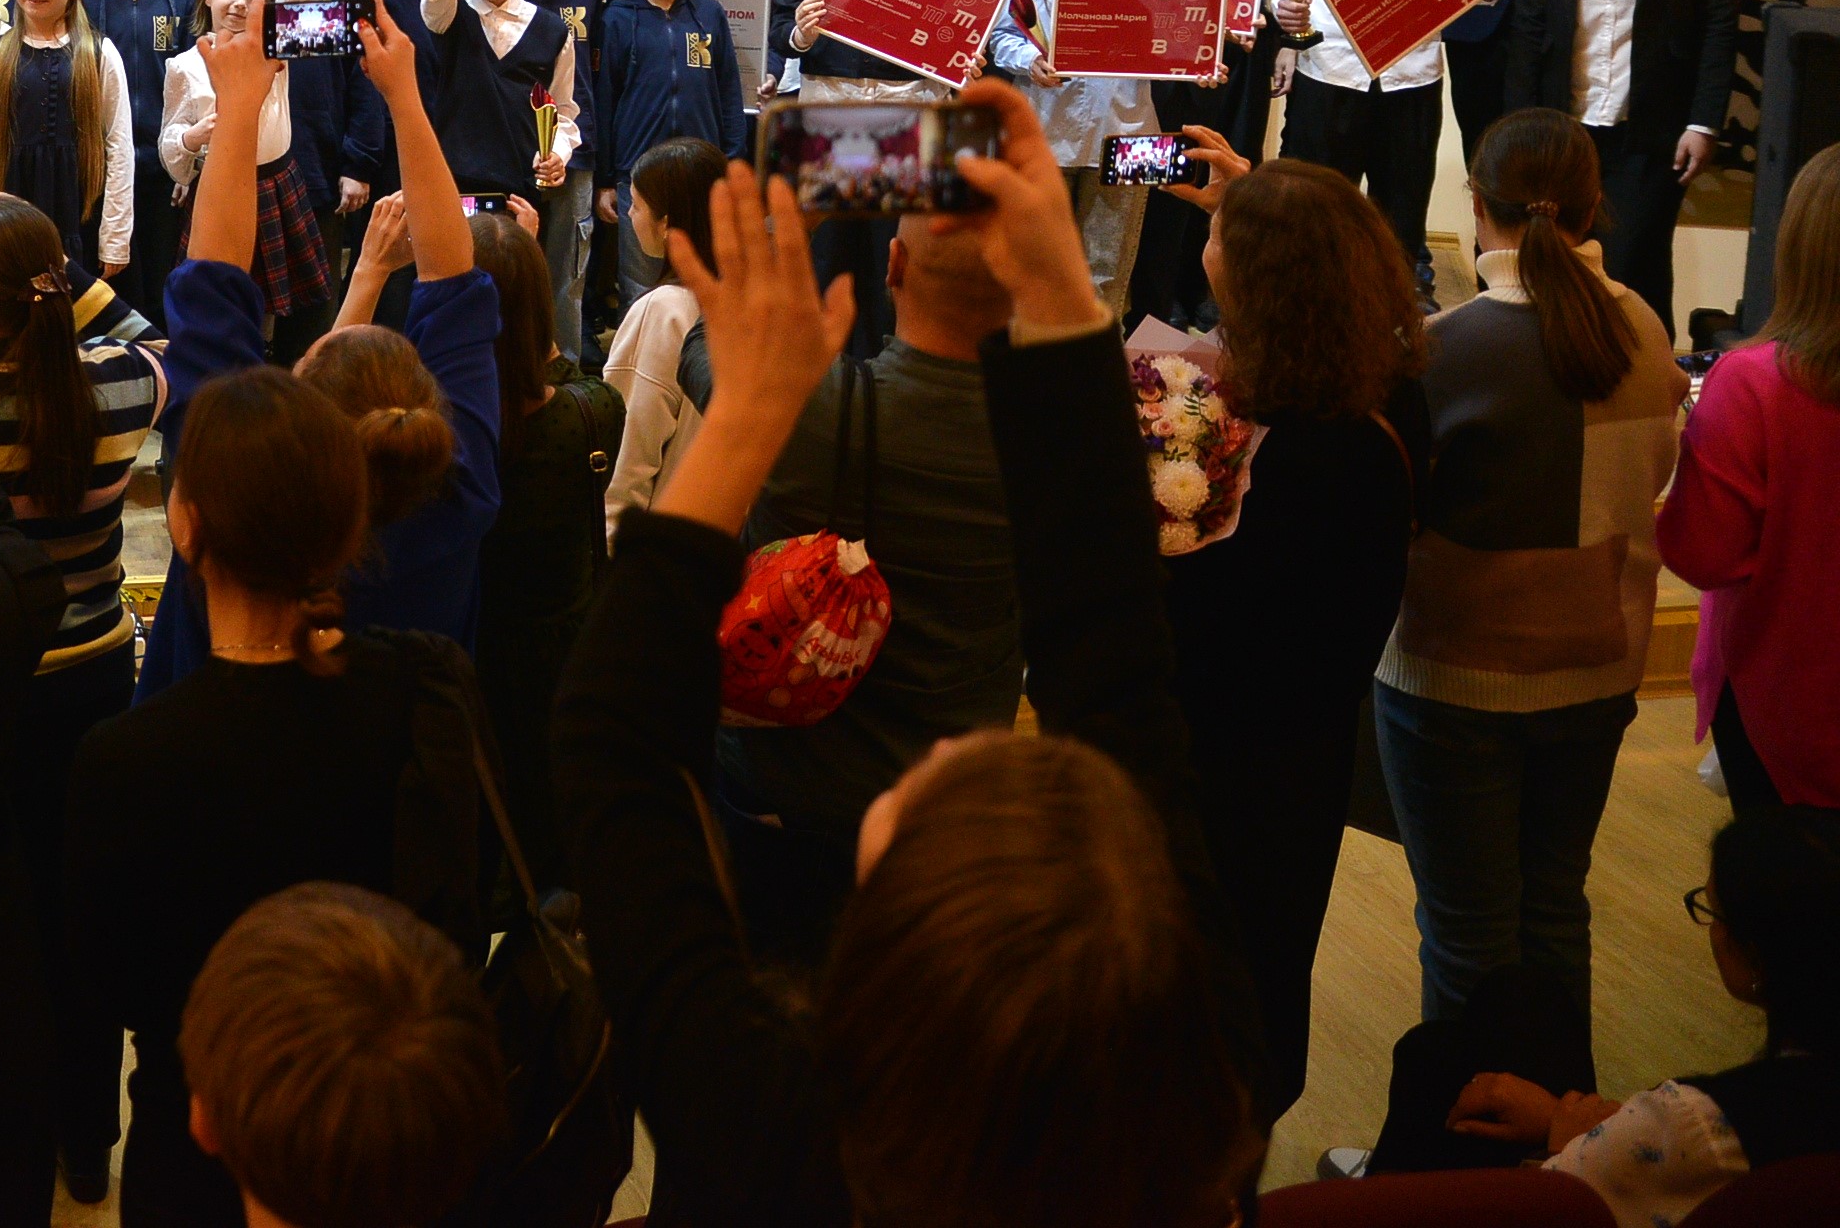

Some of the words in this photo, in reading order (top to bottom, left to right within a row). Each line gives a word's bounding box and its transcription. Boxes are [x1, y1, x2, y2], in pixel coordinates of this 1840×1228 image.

[725, 10, 755, 20] ЛОМ
[1058, 12, 1112, 21] Молчанова
[1115, 13, 1147, 23] Мария
